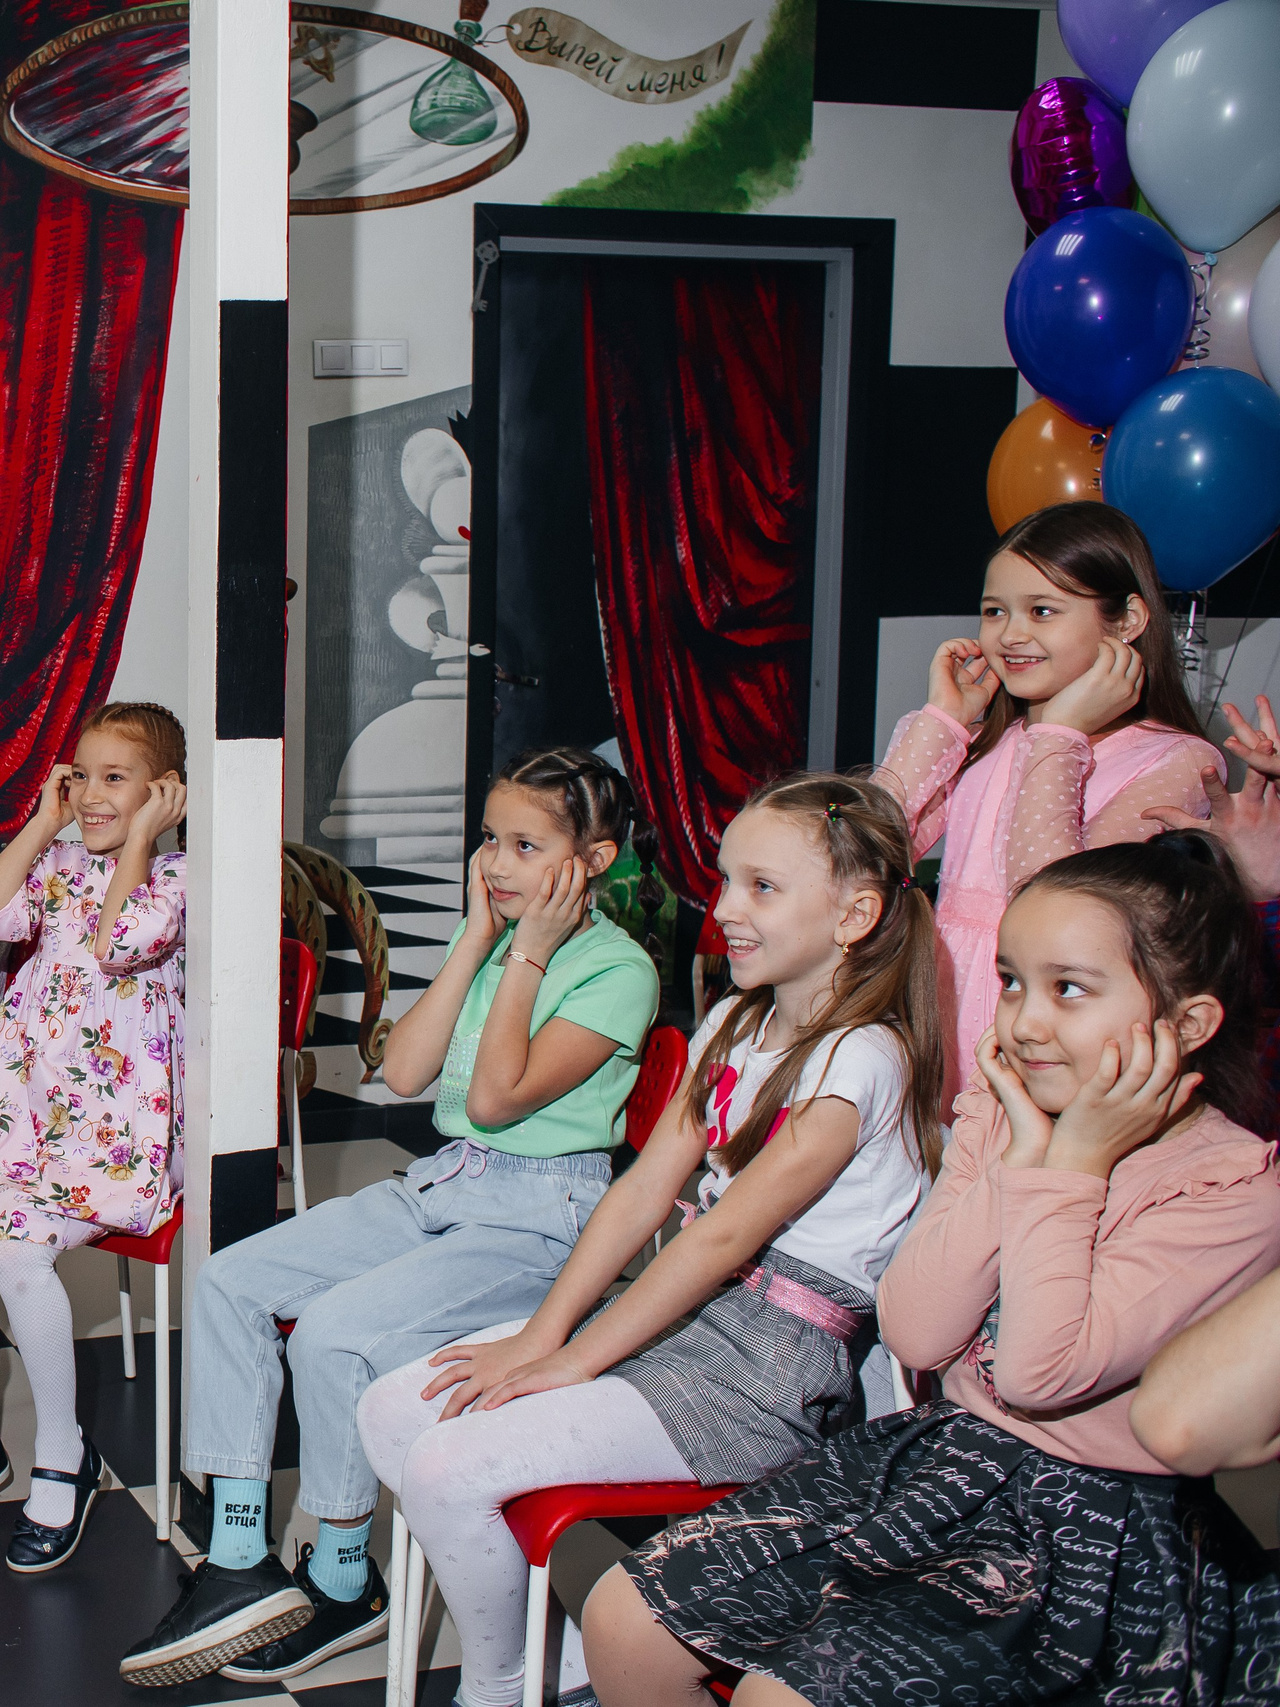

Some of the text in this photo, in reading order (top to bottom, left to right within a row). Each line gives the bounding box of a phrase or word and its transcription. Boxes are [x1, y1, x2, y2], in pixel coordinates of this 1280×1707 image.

[517, 16, 622, 84] Выпей
[224, 1503, 262, 1515] ВСЯ В
[225, 1516, 257, 1528] ОТЦА
[337, 1544, 361, 1555] ВСЯ
